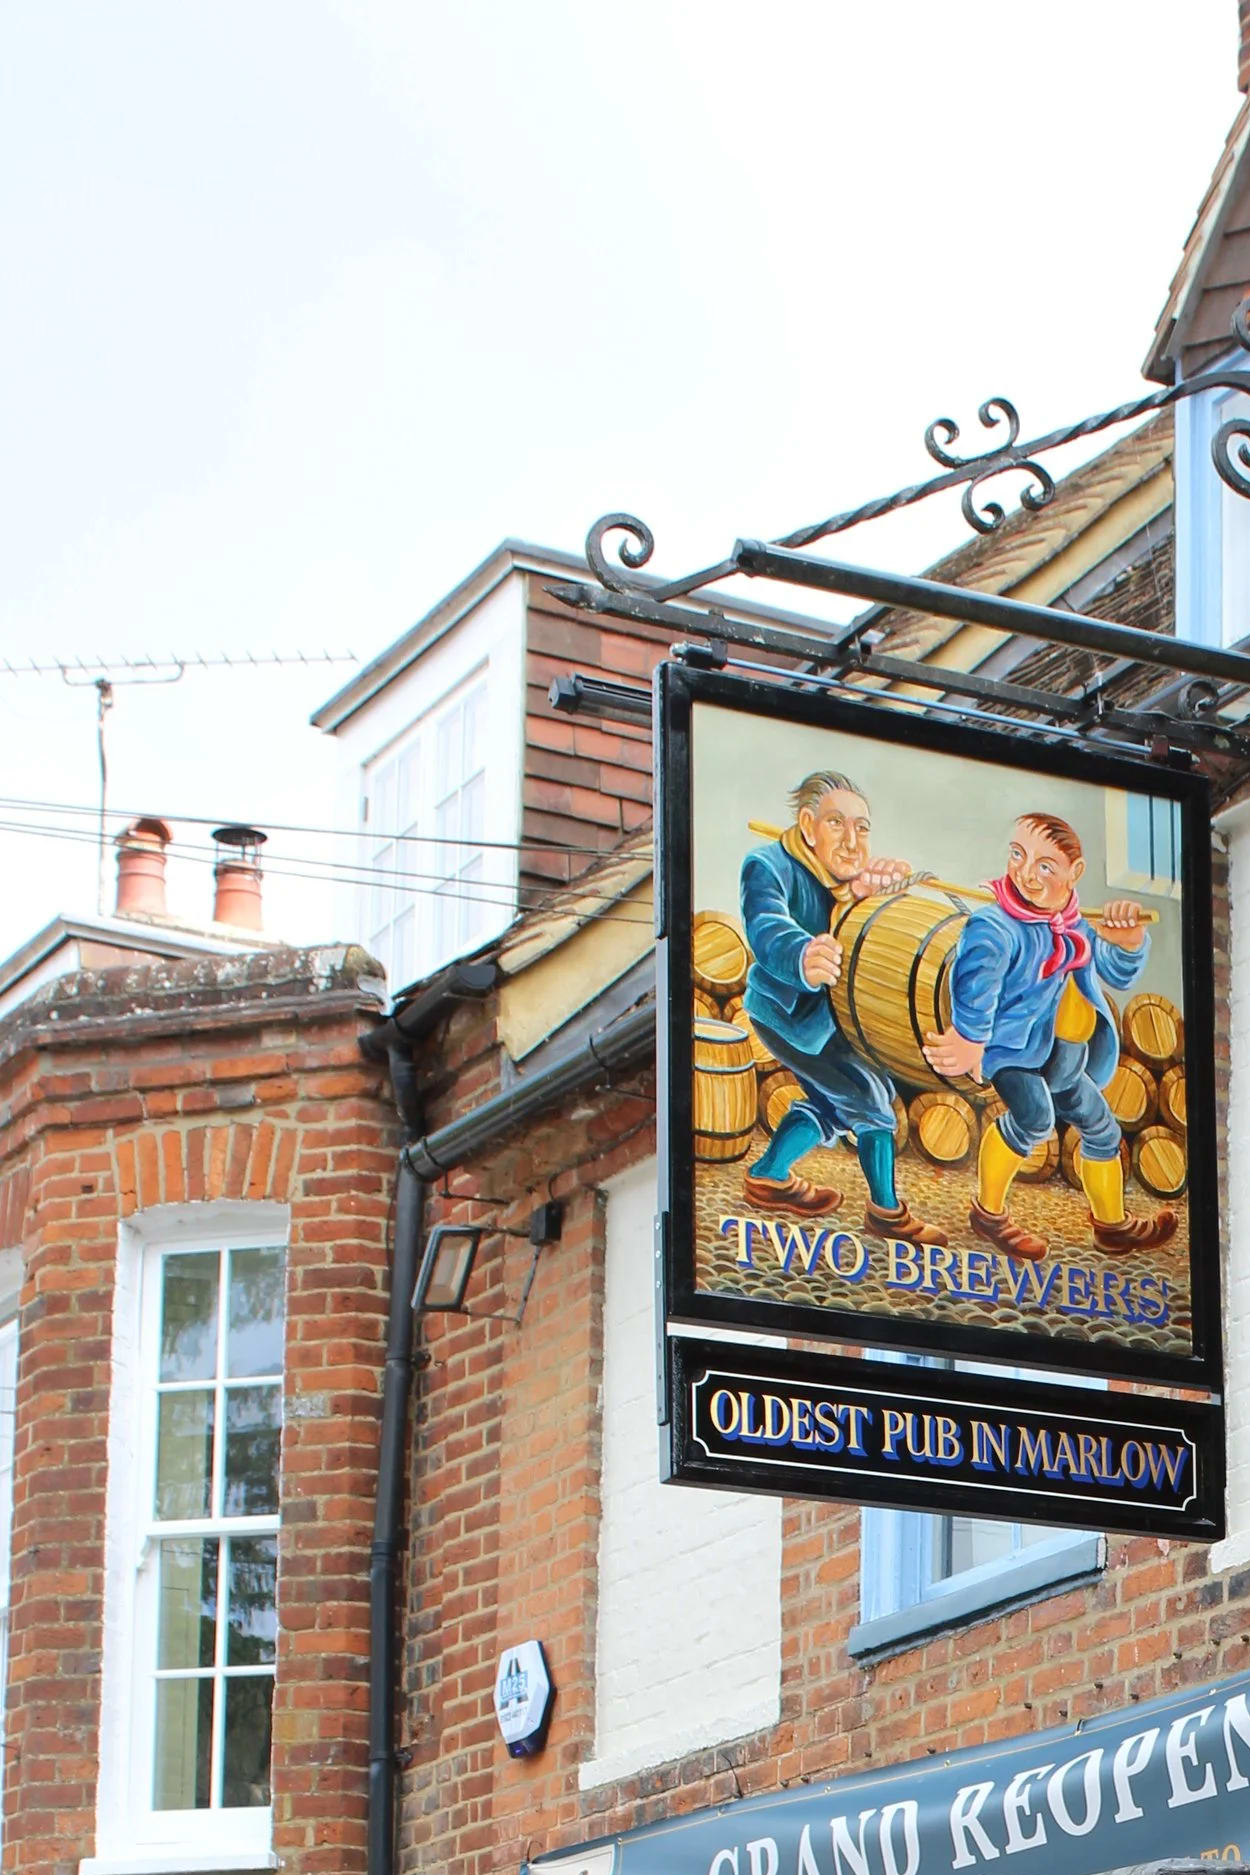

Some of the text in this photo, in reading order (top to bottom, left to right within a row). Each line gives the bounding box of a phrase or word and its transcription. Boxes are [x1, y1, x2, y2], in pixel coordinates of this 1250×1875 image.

[720, 1217, 1168, 1324] TWO BREWERS
[710, 1389, 1187, 1491] OLDEST PUB IN MARLOW
[502, 1673, 527, 1698] M25
